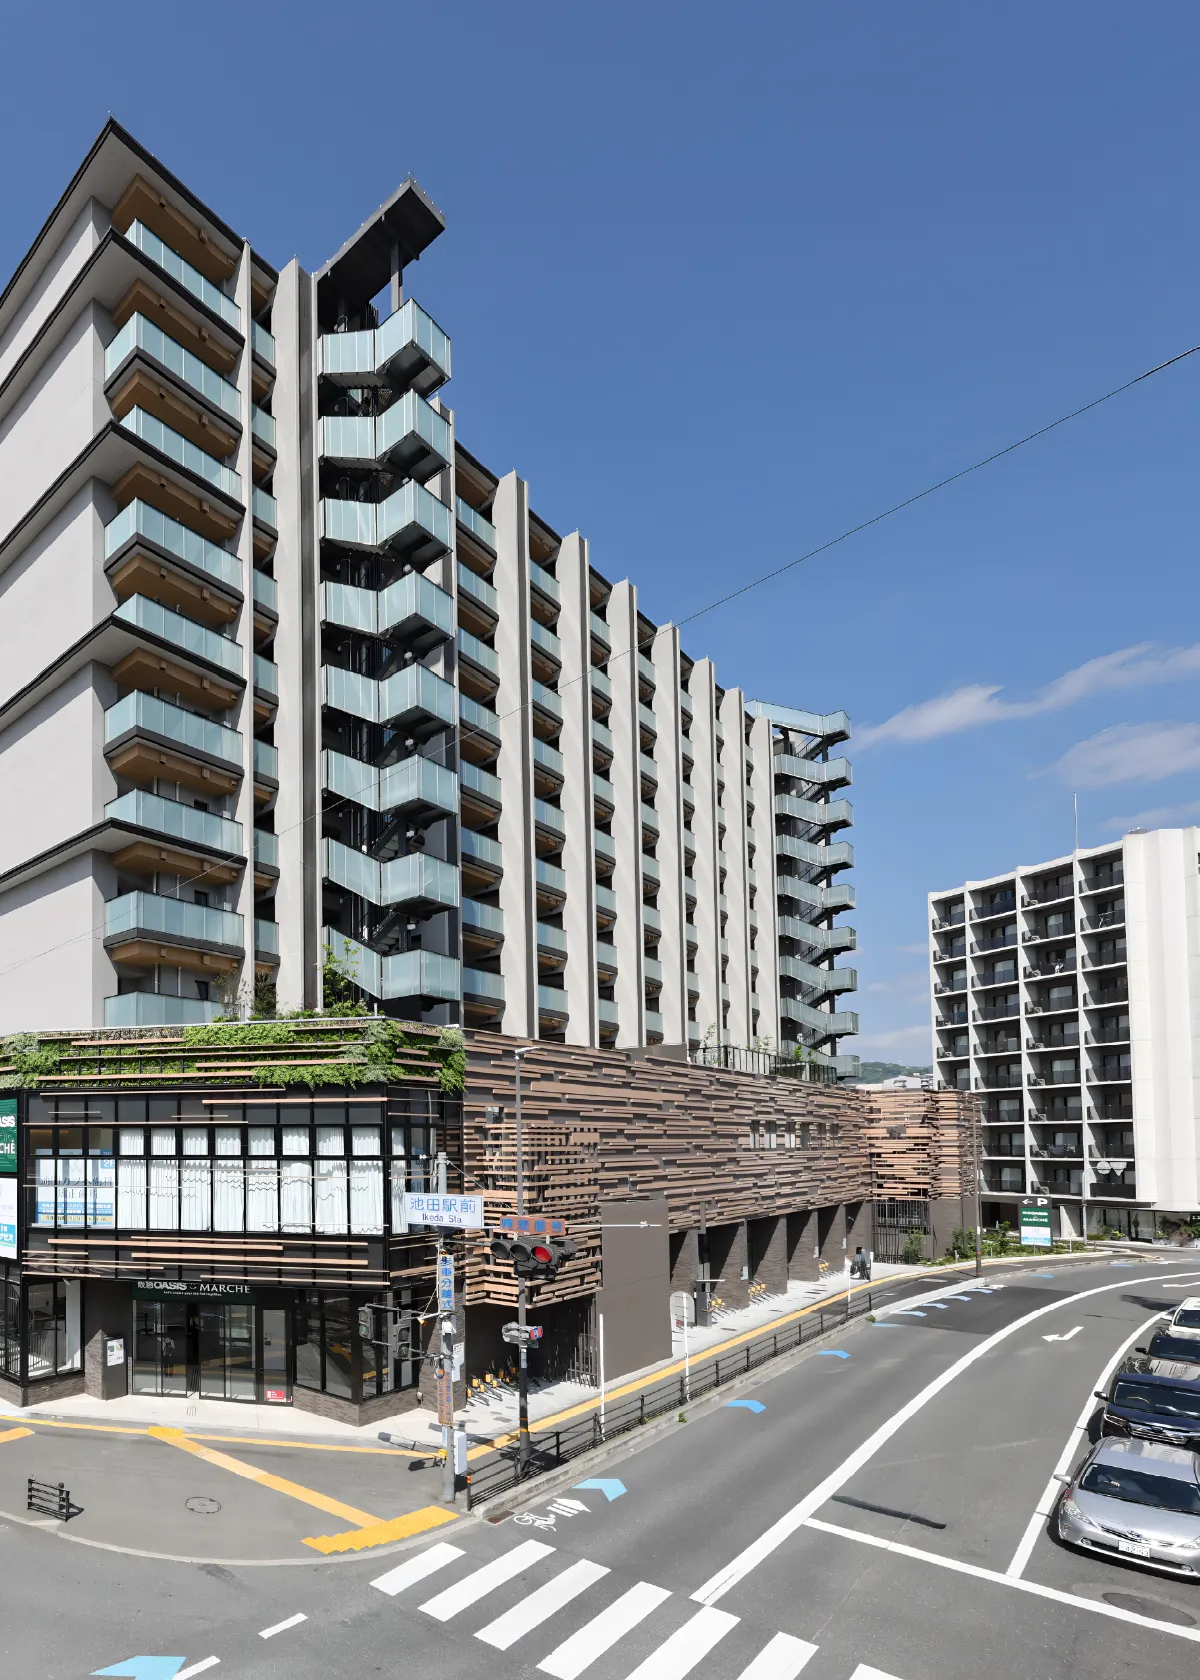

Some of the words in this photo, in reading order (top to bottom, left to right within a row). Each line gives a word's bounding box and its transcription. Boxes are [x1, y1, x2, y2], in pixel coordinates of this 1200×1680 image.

[410, 1197, 476, 1214] 池田駅前
[1037, 1198, 1048, 1206] P
[422, 1213, 444, 1222] Ikeda
[448, 1215, 464, 1224] Sta.
[440, 1256, 453, 1309] 歩車分離式
